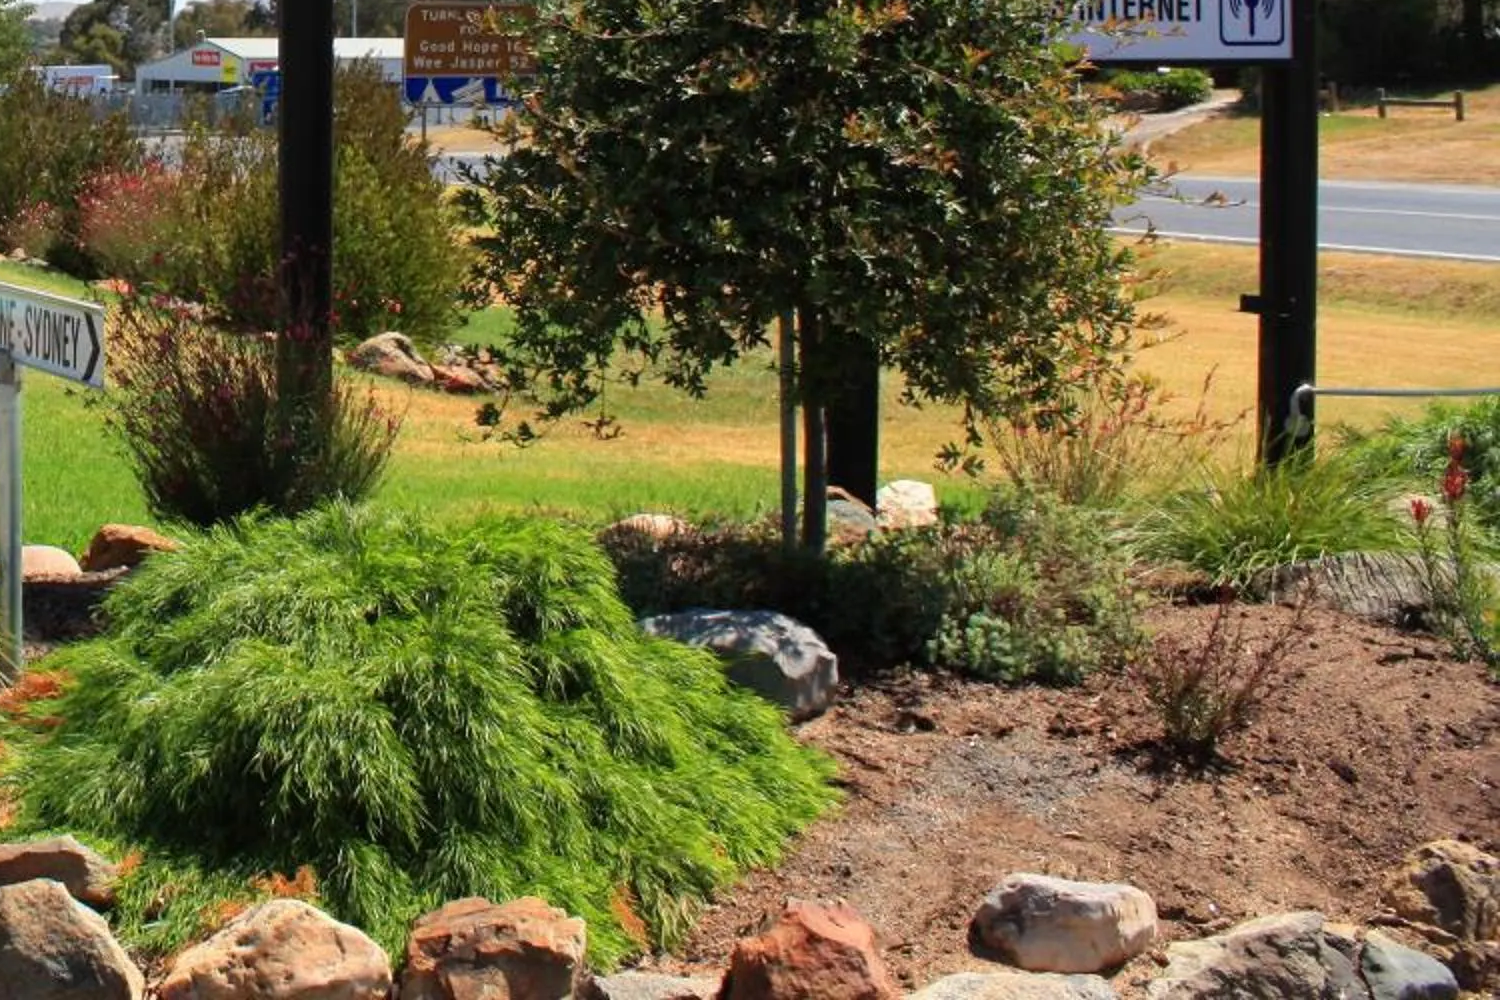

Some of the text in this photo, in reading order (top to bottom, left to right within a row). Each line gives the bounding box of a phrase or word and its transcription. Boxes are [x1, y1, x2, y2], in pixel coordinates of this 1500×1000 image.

[419, 40, 456, 53] Good
[463, 40, 500, 55] Hope
[413, 56, 443, 69] Wee
[450, 56, 502, 70] Jasper
[24, 304, 81, 370] SYDNEY
